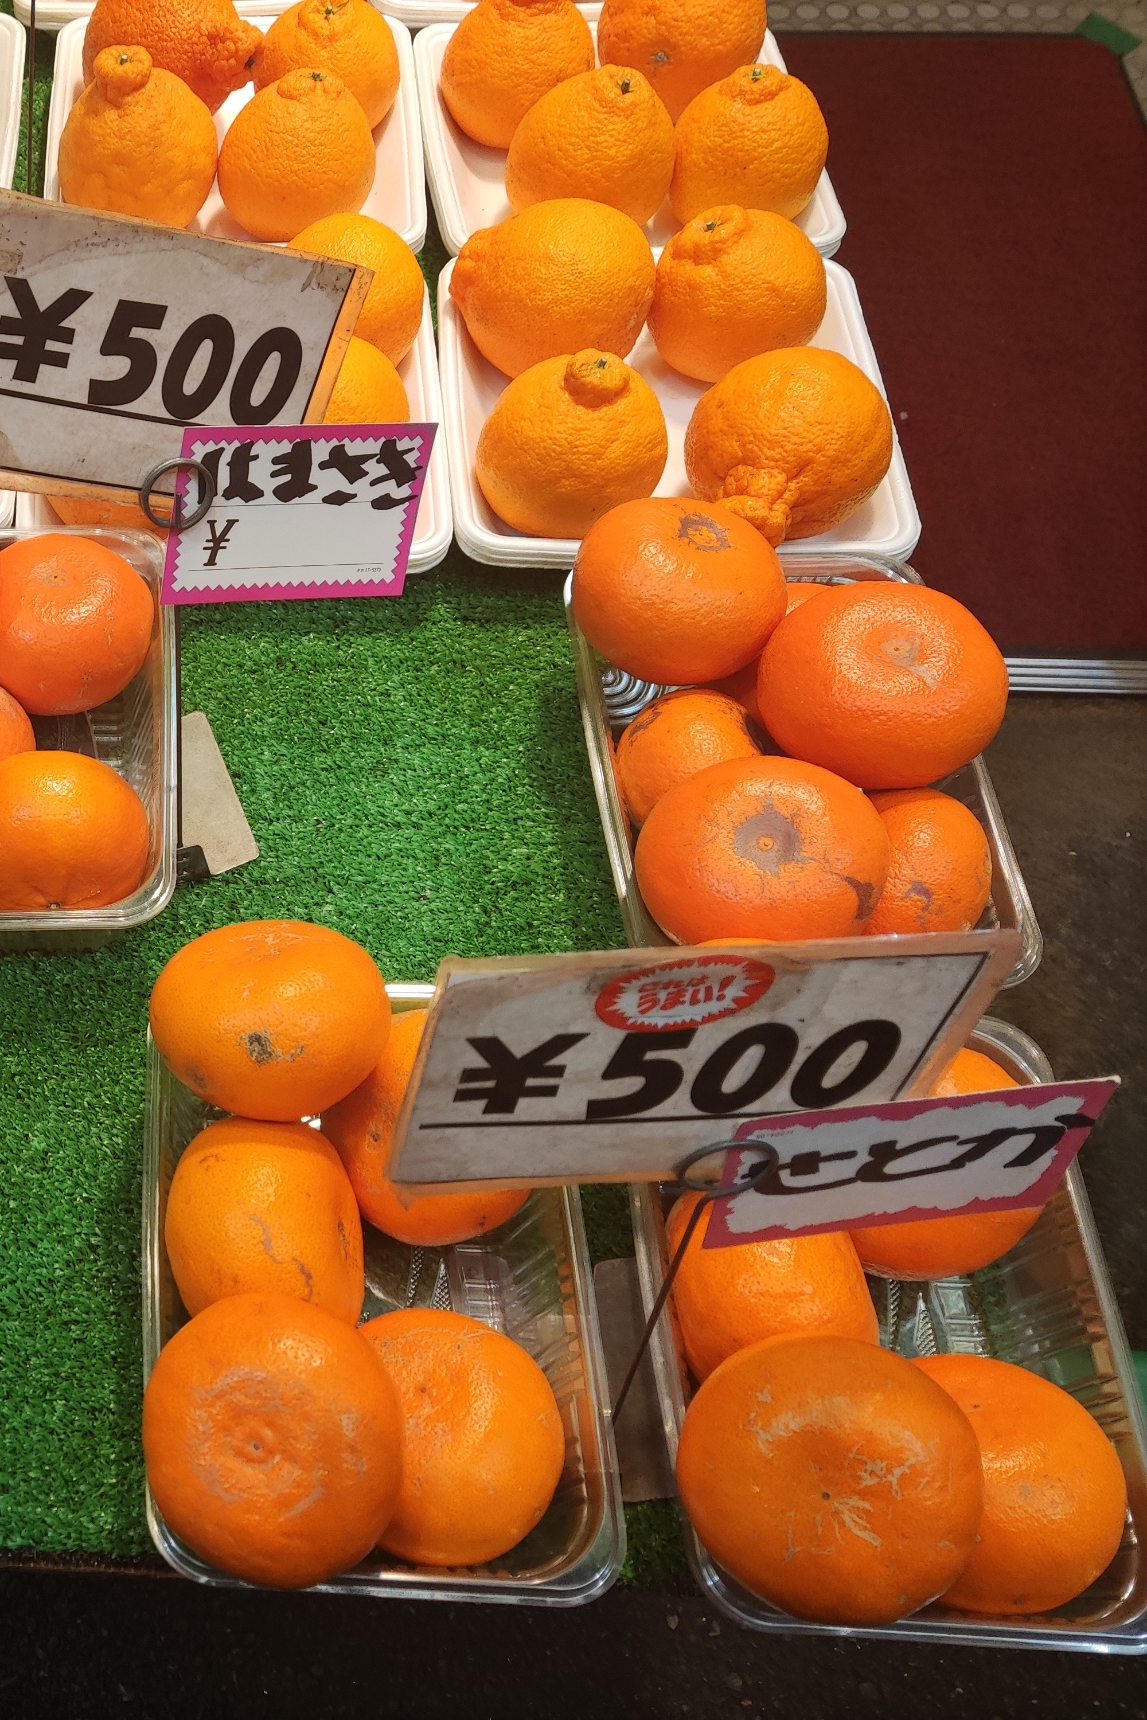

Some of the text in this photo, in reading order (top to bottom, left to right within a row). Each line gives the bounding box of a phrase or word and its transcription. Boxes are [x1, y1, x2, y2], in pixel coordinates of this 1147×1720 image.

[452, 1019, 903, 1121] ¥500
[741, 1112, 1096, 1196] せとか
